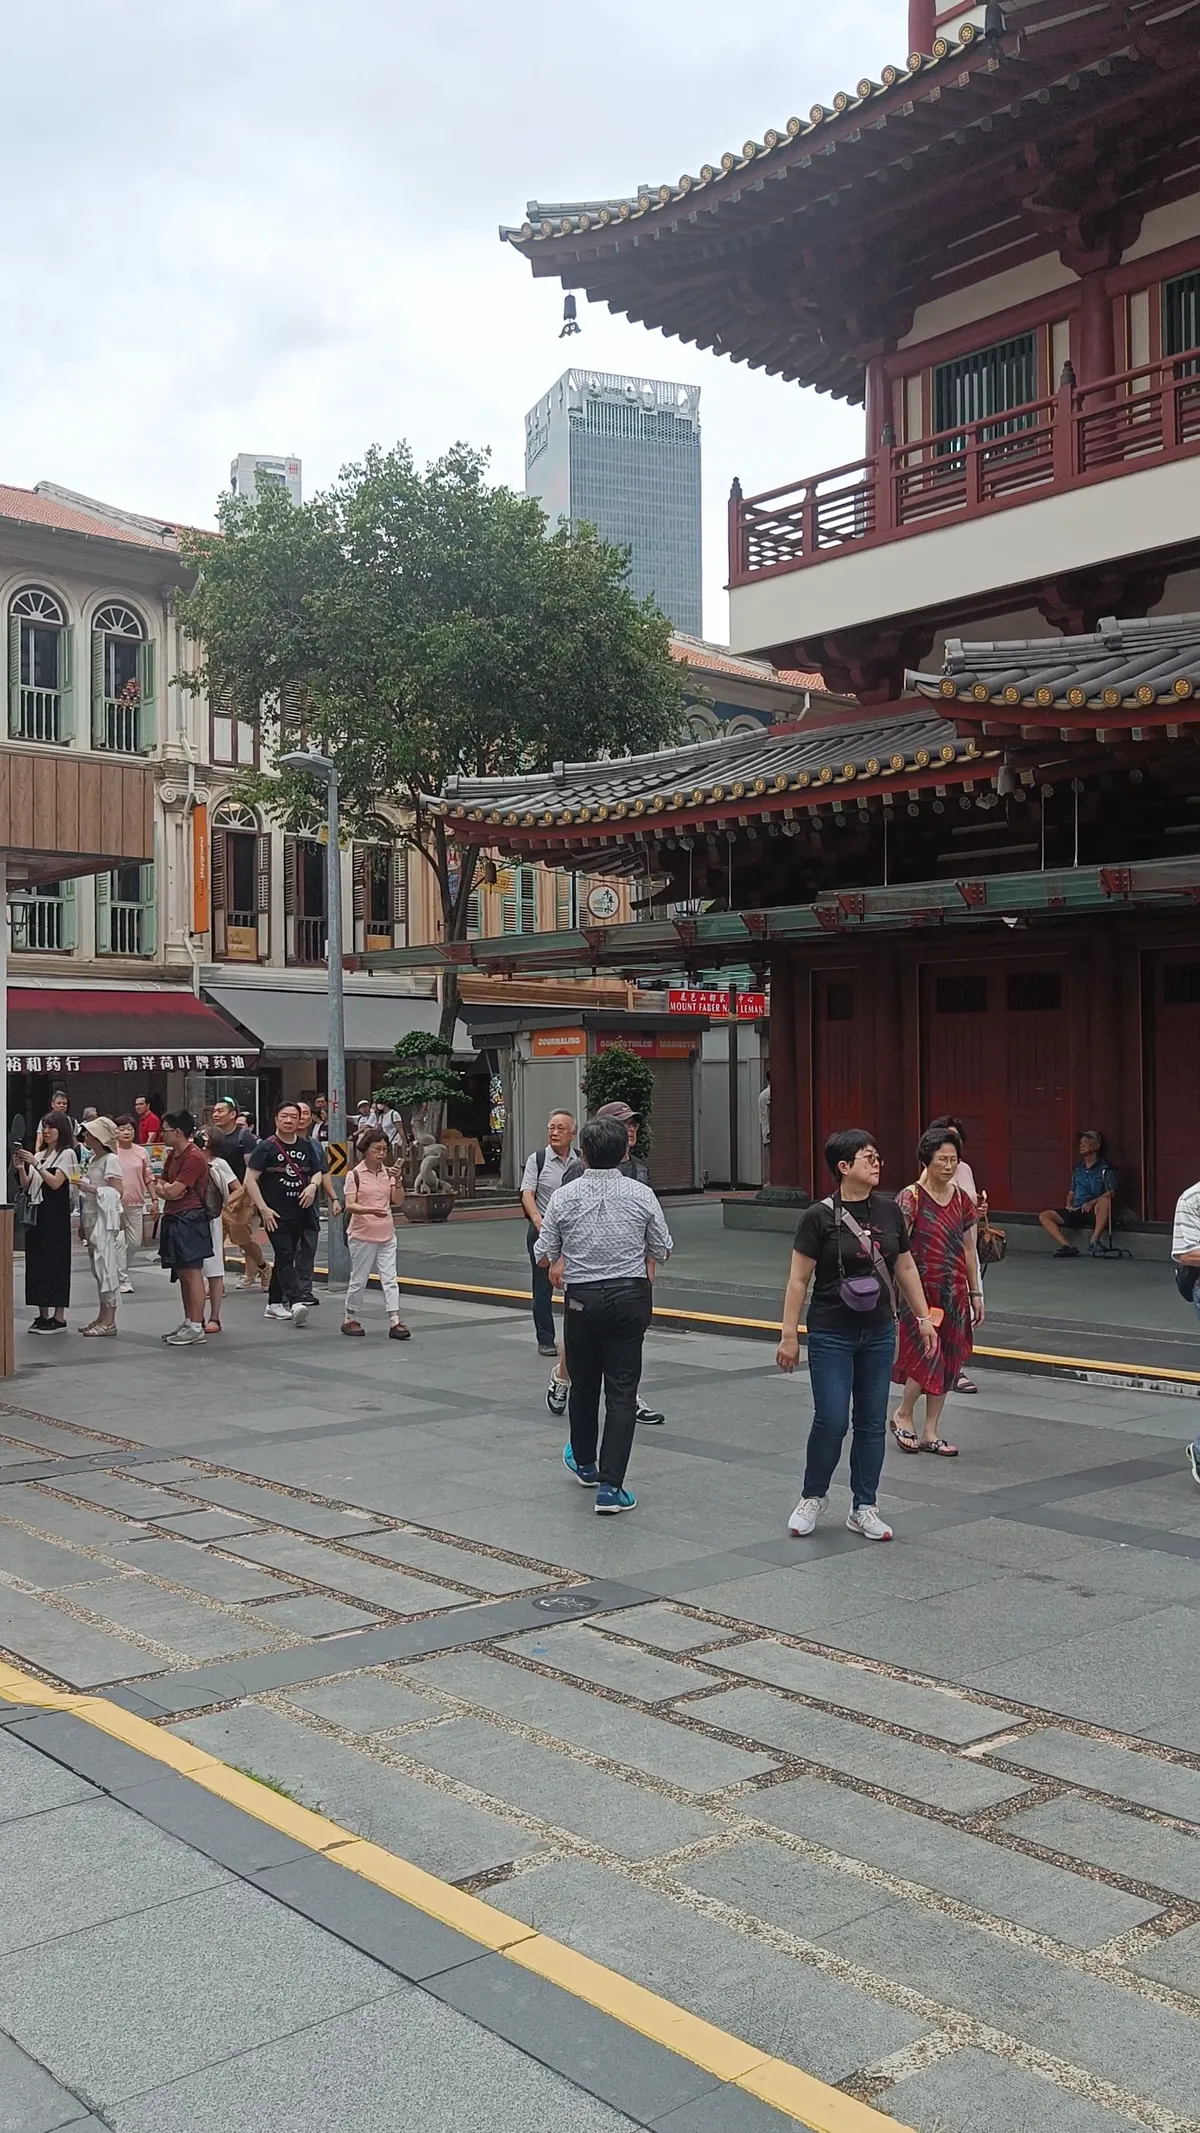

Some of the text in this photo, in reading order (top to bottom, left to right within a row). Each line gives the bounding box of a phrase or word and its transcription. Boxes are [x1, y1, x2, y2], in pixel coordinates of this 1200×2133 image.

[669, 1002, 764, 1015] MOUNT FABER NI LEMAK
[538, 1037, 580, 1046] JOURNALING
[7, 1056, 245, 1072] 裕和药行 南洋荷叶牌药油
